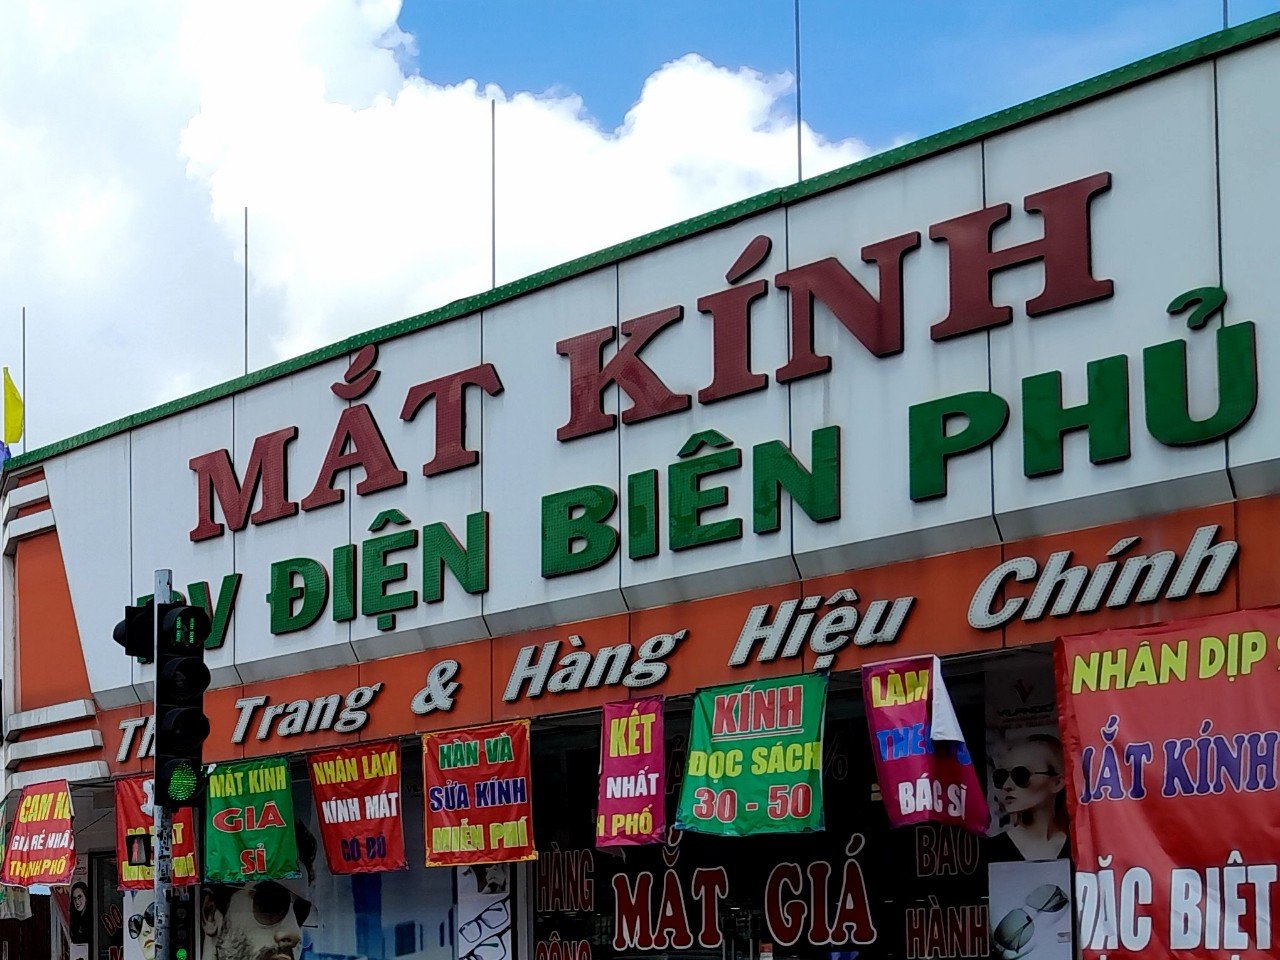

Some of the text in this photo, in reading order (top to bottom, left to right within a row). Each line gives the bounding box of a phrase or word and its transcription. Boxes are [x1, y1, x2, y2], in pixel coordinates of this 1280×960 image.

[188, 171, 1114, 542] MẮT KÍNH
[265, 508, 490, 631] ĐIỆN
[541, 429, 841, 579] BIÊN
[908, 286, 1258, 503] PHỦ
[231, 681, 384, 744] Trang
[411, 658, 462, 713] &
[503, 628, 689, 697] Hàng
[728, 588, 917, 670] Hiệu
[967, 524, 1239, 630] Chính
[1071, 640, 1188, 695] NHÂN
[1198, 631, 1267, 683] DỊP
[713, 683, 804, 736] KÍNH
[871, 669, 929, 708] LÀM
[609, 701, 656, 757] KẾT
[313, 751, 398, 788] NHẬN LÀM
[438, 732, 514, 770] HÀN VÀ
[688, 748, 744, 784] ĐỌC
[751, 741, 821, 776] SÁCH
[1162, 719, 1279, 797] KÍNH
[209, 762, 287, 799] MẮT KÍNH
[429, 779, 470, 812] SỬA
[475, 776, 527, 808] KÍNH
[606, 765, 660, 799] NHẤT
[898, 772, 944, 816] BÁC
[322, 796, 361, 824] KÍNH
[365, 789, 399, 820] MÁT
[611, 803, 653, 837] PHỐ
[693, 787, 737, 823] 30
[768, 783, 813, 820] 50
[432, 816, 528, 853] MIỄN PHÍ
[241, 843, 267, 875] SỈ
[537, 842, 595, 912] HÀNG
[611, 826, 877, 951] MẮT GIÁ
[905, 895, 990, 960] HÀNH
